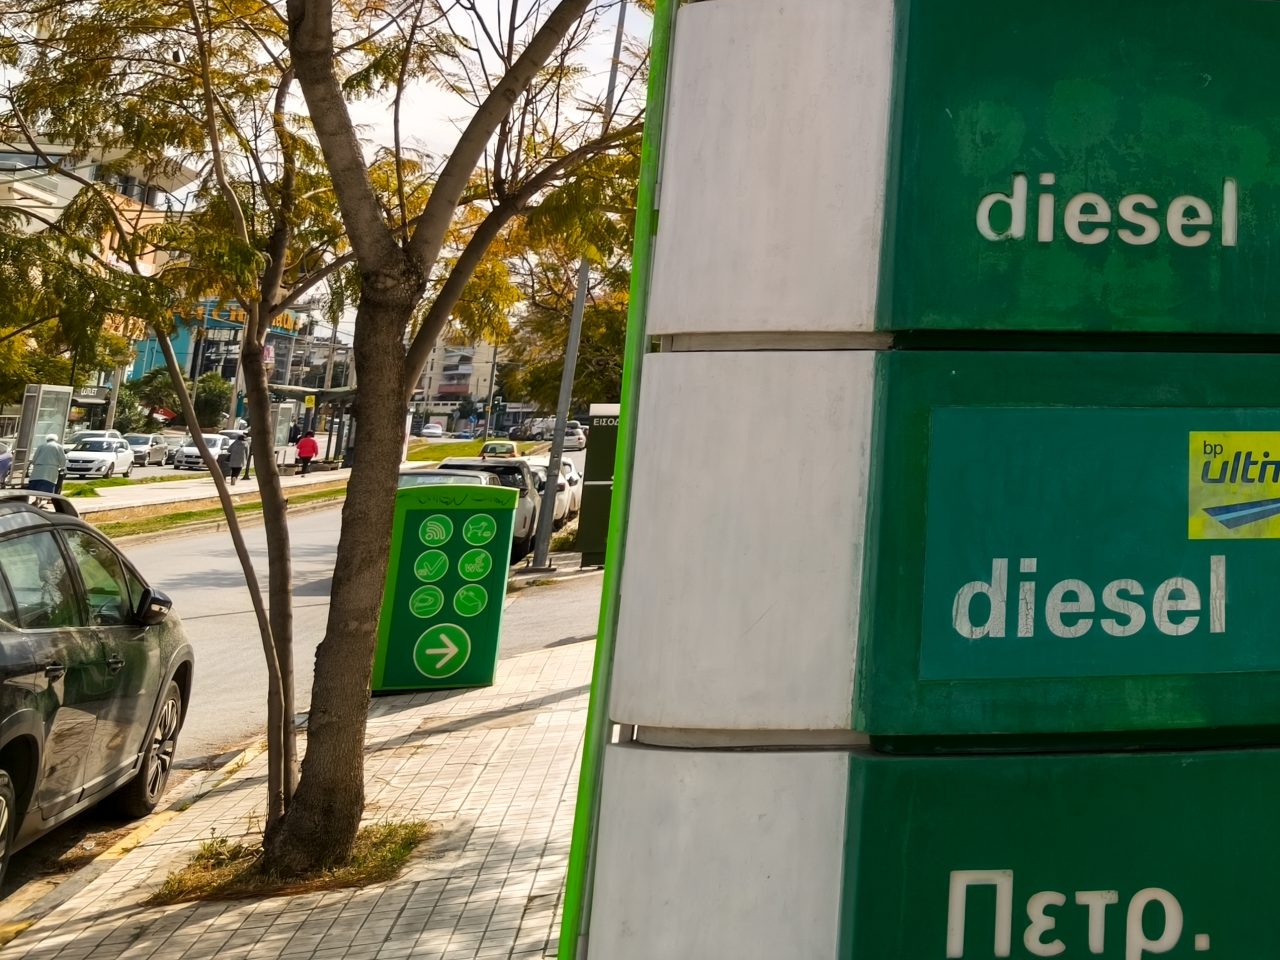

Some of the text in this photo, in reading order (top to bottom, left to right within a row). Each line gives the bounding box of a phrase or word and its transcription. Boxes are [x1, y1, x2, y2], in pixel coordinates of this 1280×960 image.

[975, 171, 1239, 248] diesel
[1202, 440, 1224, 458] bp
[951, 554, 1227, 640] diesel
[946, 869, 1211, 960] Πετρ.
